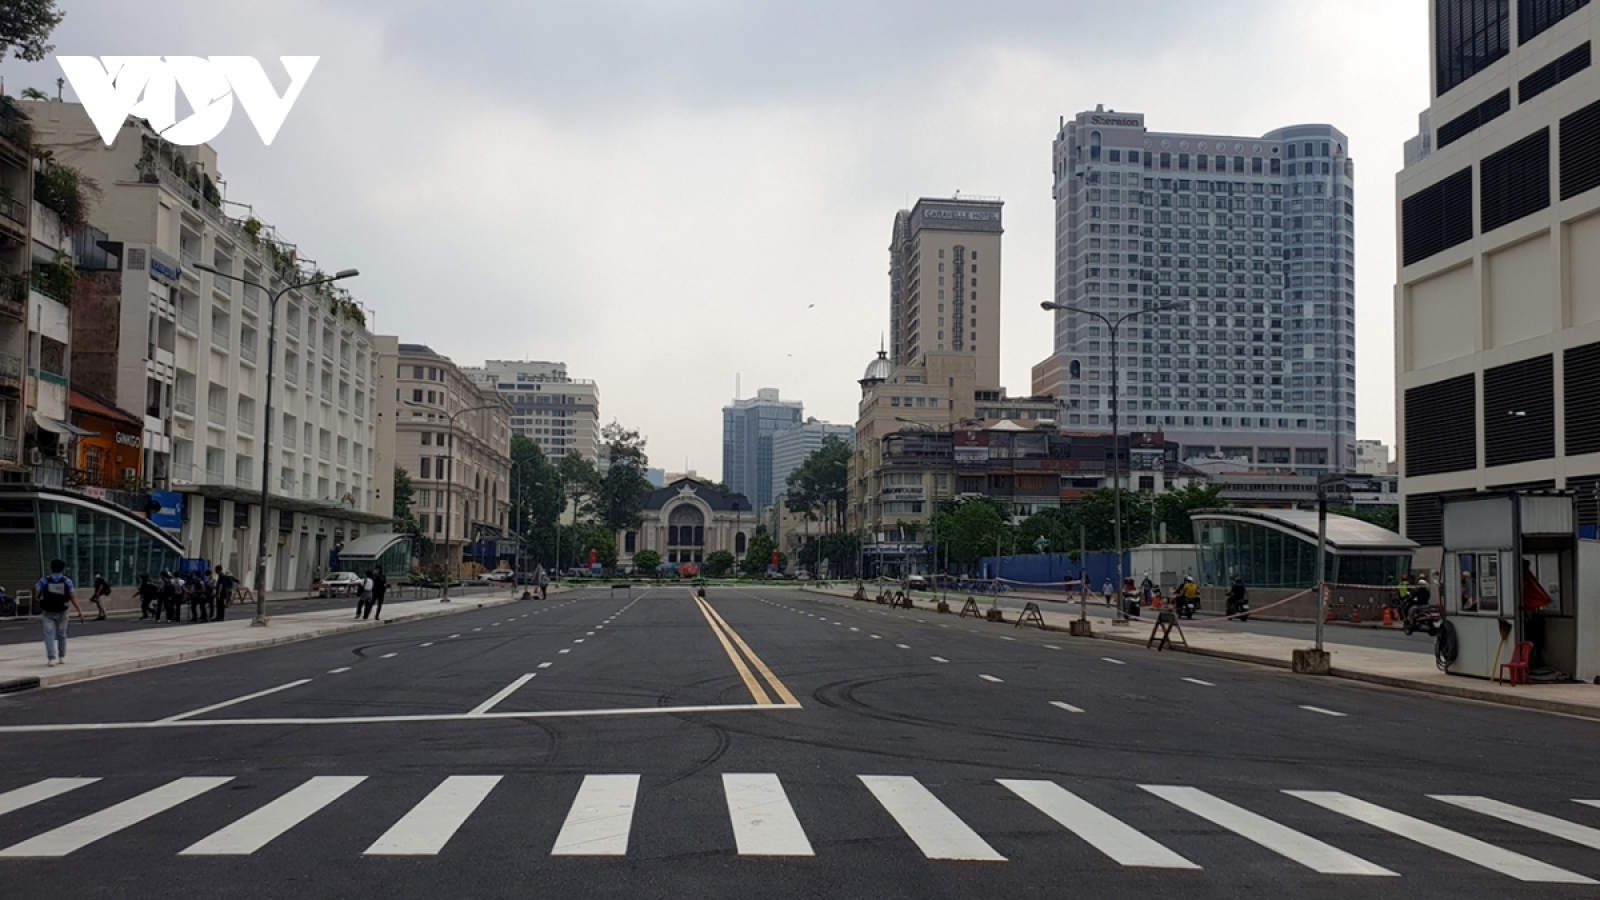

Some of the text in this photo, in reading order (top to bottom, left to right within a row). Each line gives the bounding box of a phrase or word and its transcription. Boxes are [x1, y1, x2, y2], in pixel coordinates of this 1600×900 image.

[1091, 115, 1139, 127] Sheraton
[926, 210, 997, 221] CARAVELLE HOTEL
[115, 431, 141, 449] GINKGO
